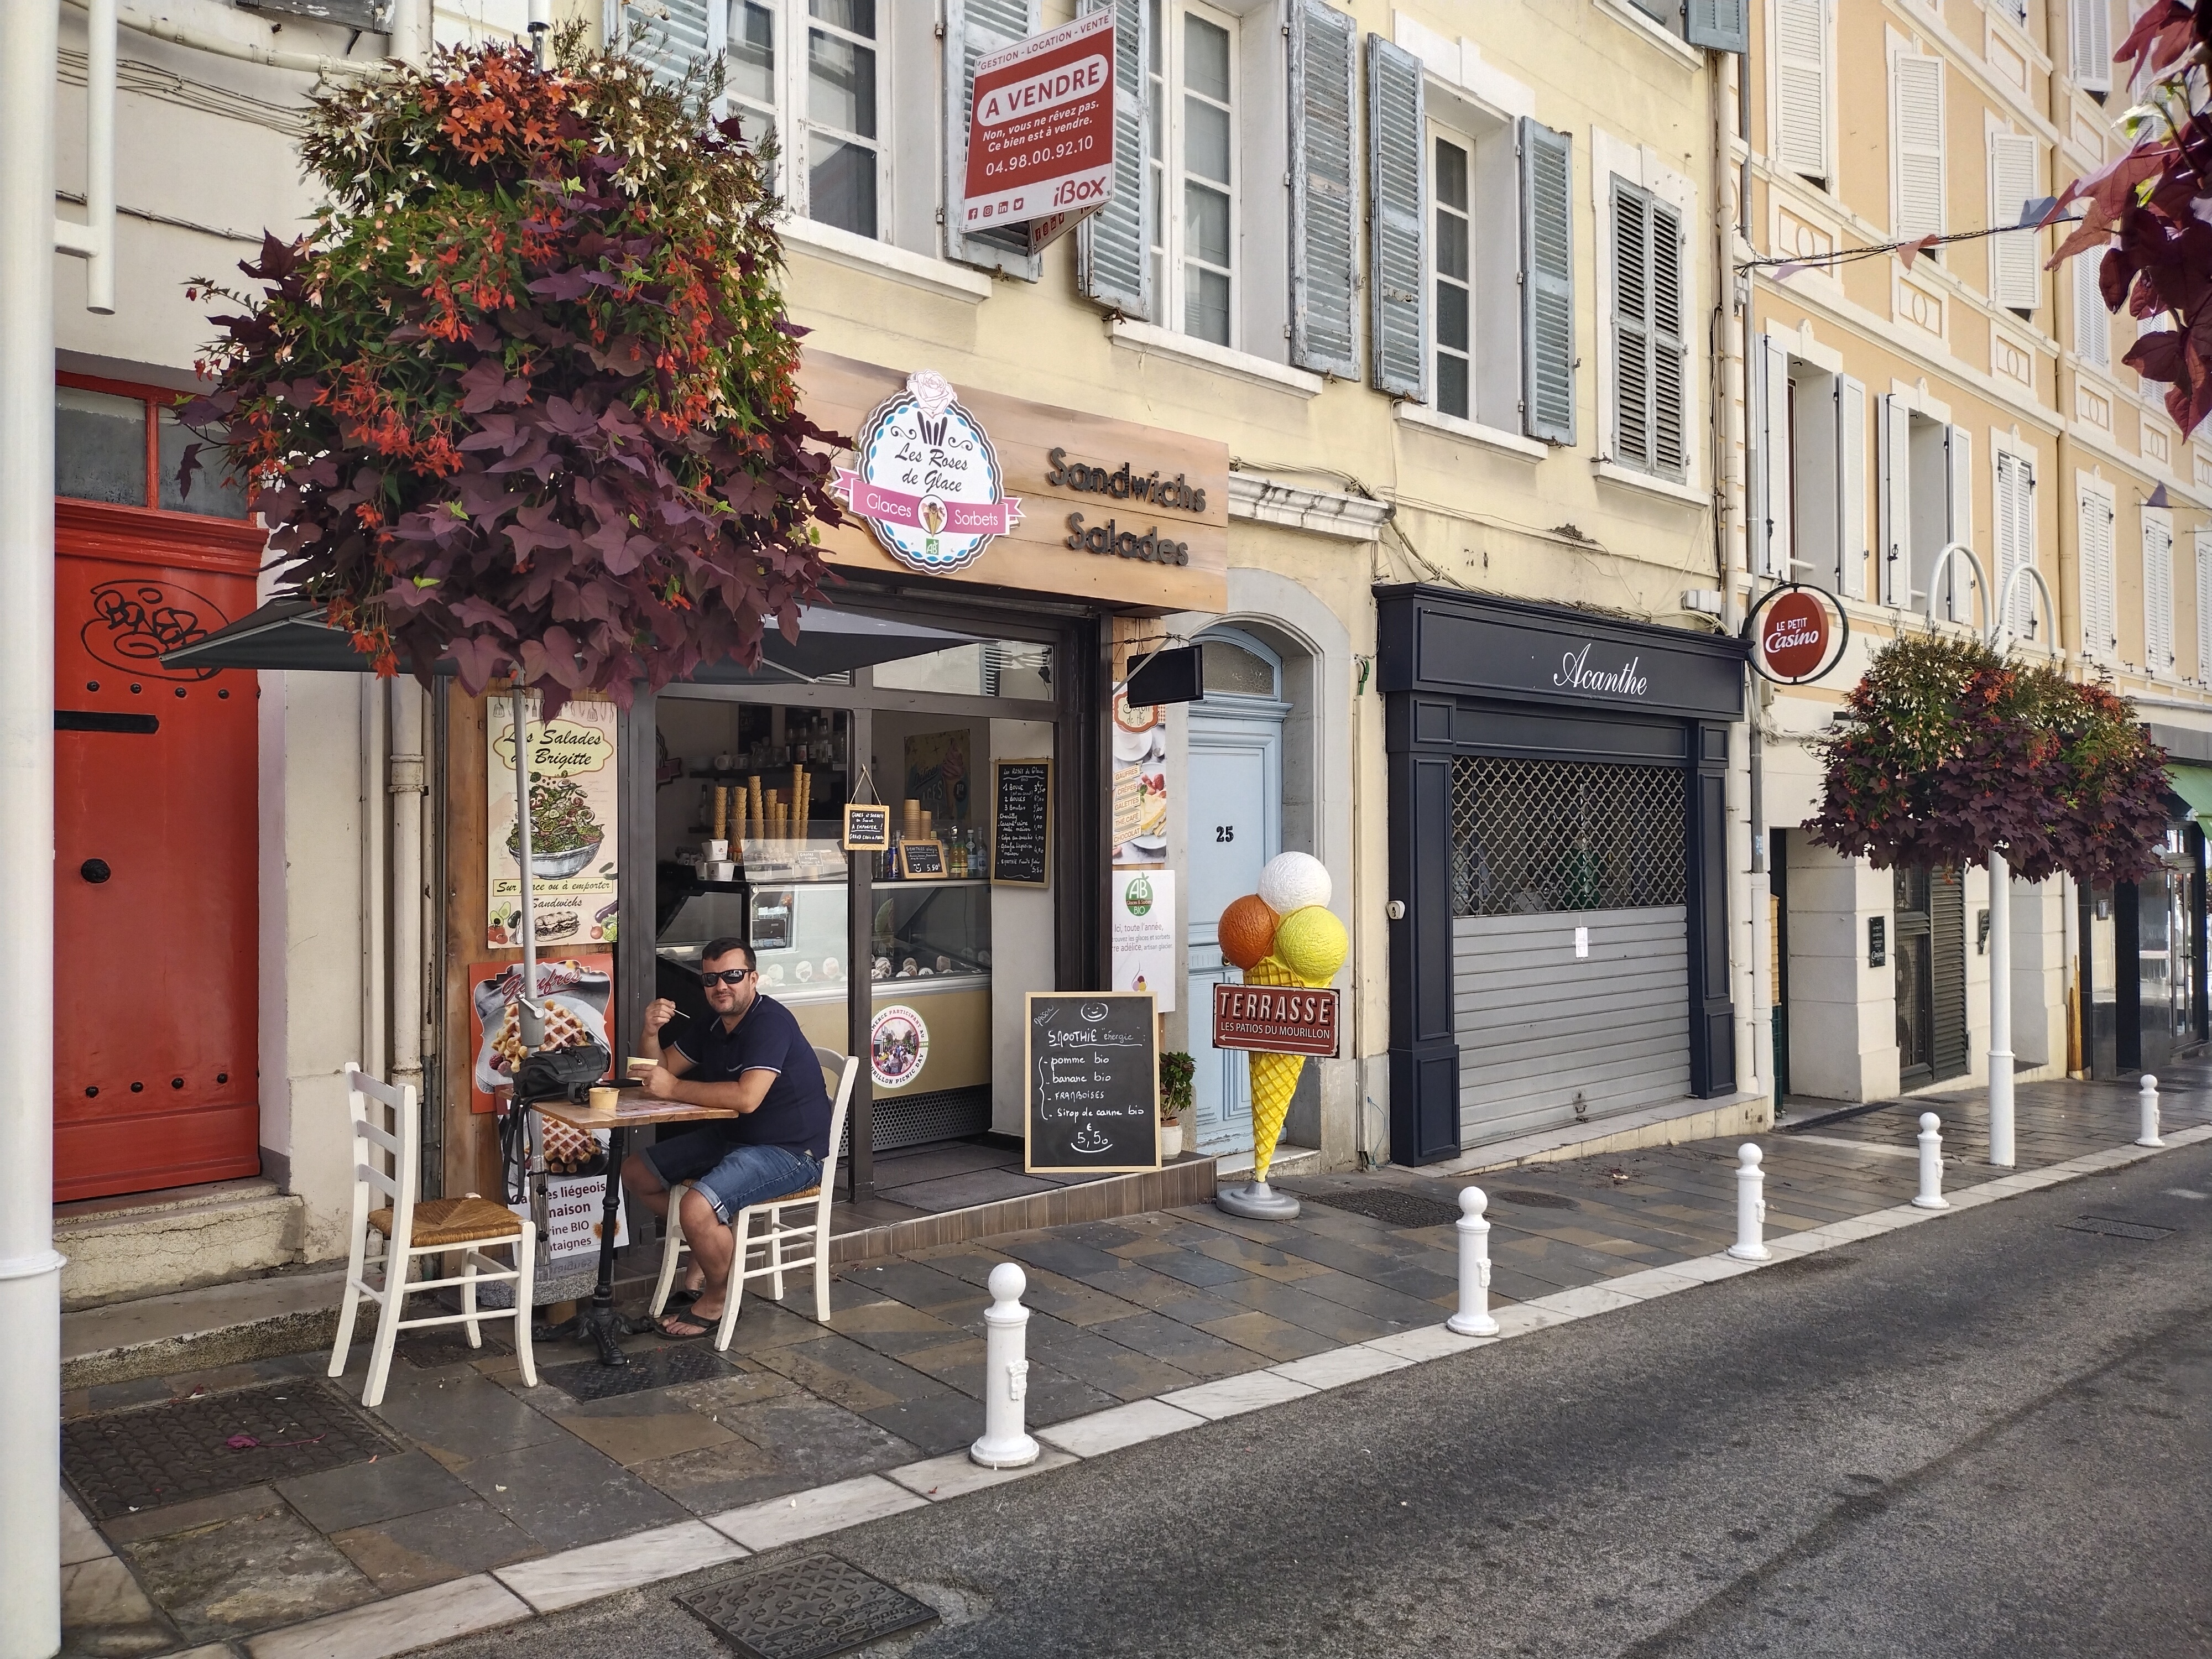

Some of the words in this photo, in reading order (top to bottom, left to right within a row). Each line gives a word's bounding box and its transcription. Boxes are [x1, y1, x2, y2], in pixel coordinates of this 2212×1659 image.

[980, 50, 1018, 70] GESTION
[1027, 30, 1072, 54] LOCATION
[1081, 15, 1109, 34] VENTE
[985, 98, 1000, 119] A
[1008, 62, 1100, 112] VENDRE
[983, 130, 1005, 142] Non,
[1009, 122, 1031, 134] vous
[1034, 117, 1046, 127] ne
[1048, 107, 1076, 123] rêvez
[1078, 102, 1099, 118] pas.
[988, 141, 1001, 153] Ce
[1004, 134, 1026, 149] bien
[1027, 129, 1044, 142] est
[1046, 126, 1051, 137] à
[1054, 116, 1093, 134] vendre.
[986, 135, 1093, 176] 04.98.00.92.10
[895, 442, 922, 462] Les
[928, 449, 968, 470] Roses
[902, 468, 919, 484] de
[924, 470, 962, 493] Glace
[1050, 447, 1206, 512] Sandwichs
[867, 493, 911, 518] Glaces
[954, 509, 998, 526] Sorbets
[1068, 512, 1188, 566] Salades
[1777, 621, 1785, 632] LE
[1787, 617, 1807, 630] PETIT
[1765, 629, 1819, 653] Casino
[1553, 643, 1647, 695] Acanthe
[540, 729, 601, 745] Salades
[535, 748, 592, 770] Brigitte
[1115, 765, 1138, 781] GAUFRES
[1117, 784, 1136, 796] CRÊPES
[1115, 797, 1139, 811] GALETTES
[1114, 828, 1139, 843] CHOCOLAT
[1216, 826, 1234, 842] 25
[497, 882, 517, 893] Sur
[562, 880, 568, 889] à
[572, 880, 610, 892] emporter
[1129, 879, 1148, 899] AB
[1134, 906, 1145, 915] BIO
[1219, 991, 1331, 1024] TERRASSE
[889, 1009, 922, 1028] PARTICIPANT
[920, 1030, 925, 1039] AU
[1221, 1022, 1234, 1031] LES
[1236, 1022, 1263, 1034] PATIOS
[1265, 1025, 1277, 1035] DU
[1279, 1026, 1331, 1039] MOURILLON
[1051, 1057, 1086, 1071] pomme
[1094, 1051, 1109, 1064] bio
[895, 1068, 916, 1084] PICNIC
[1052, 1071, 1087, 1083] banane
[1094, 1070, 1111, 1082] bio
[1082, 1107, 1093, 1117] de
[1096, 1108, 1123, 1117] canne
[1128, 1105, 1144, 1115] bio
[561, 1181, 606, 1198] liégeois
[571, 1220, 589, 1233] BIO
